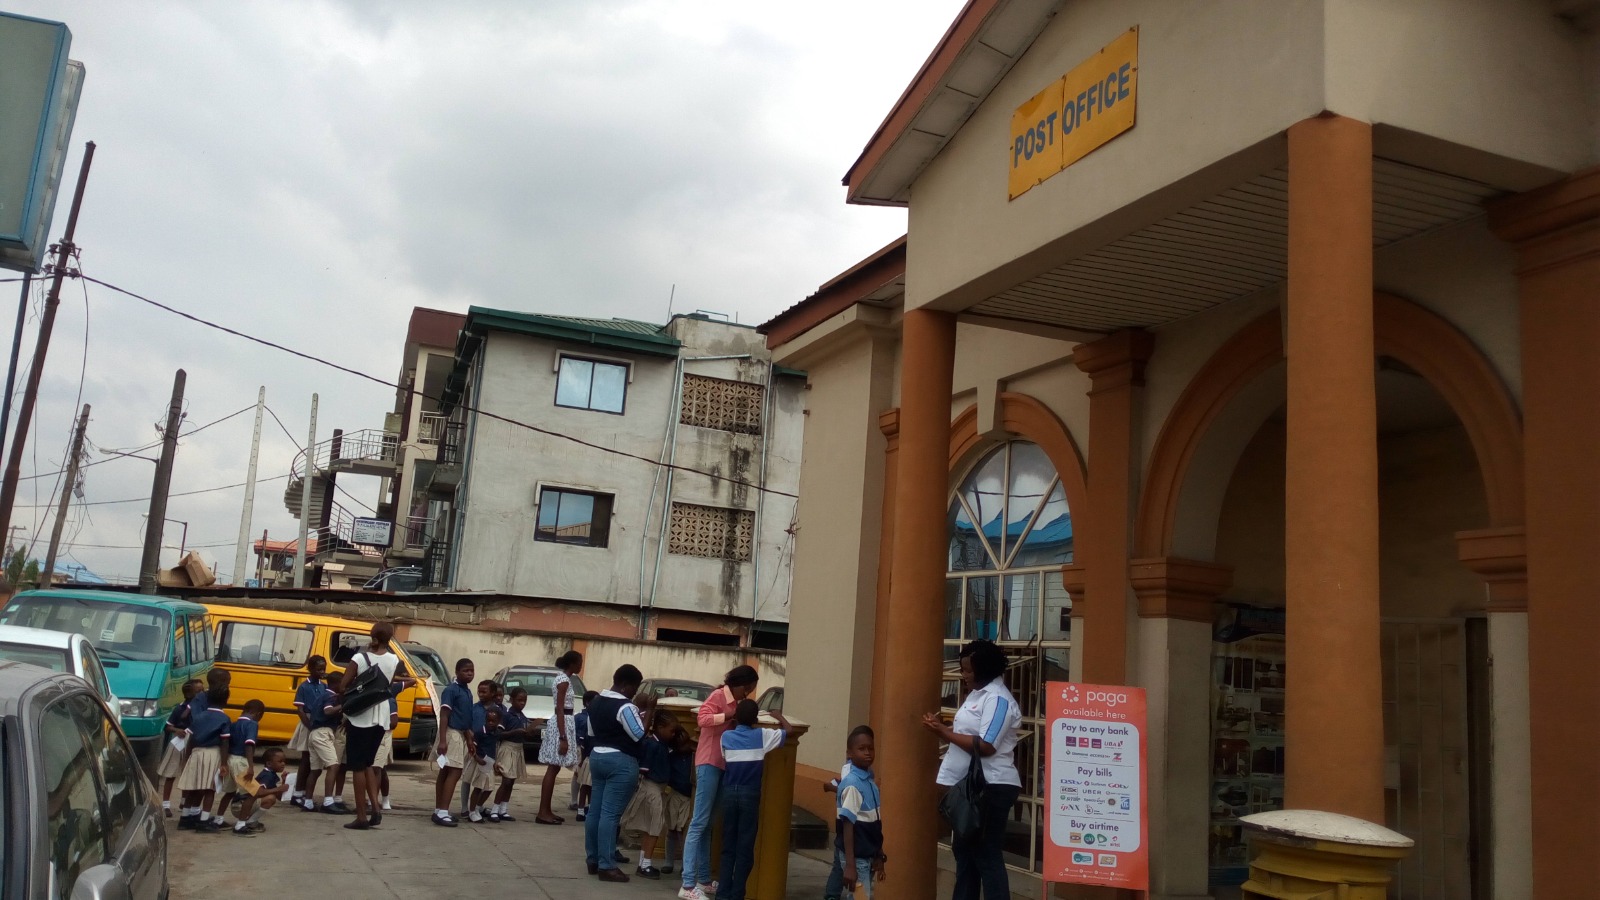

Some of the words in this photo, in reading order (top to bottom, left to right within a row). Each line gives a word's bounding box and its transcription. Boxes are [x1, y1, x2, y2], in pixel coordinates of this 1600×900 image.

[1013, 110, 1058, 169] POST
[1062, 61, 1131, 135] OFFICE
[1086, 691, 1127, 707] paga
[1062, 708, 1104, 718] available
[1106, 709, 1126, 719] here
[1061, 722, 1077, 733] Pay
[1089, 726, 1105, 736] any
[1107, 726, 1129, 736] bank
[1077, 766, 1093, 777] Pay
[1095, 768, 1112, 777] bills
[1070, 820, 1086, 831] Buy
[1089, 822, 1119, 832] airtime
